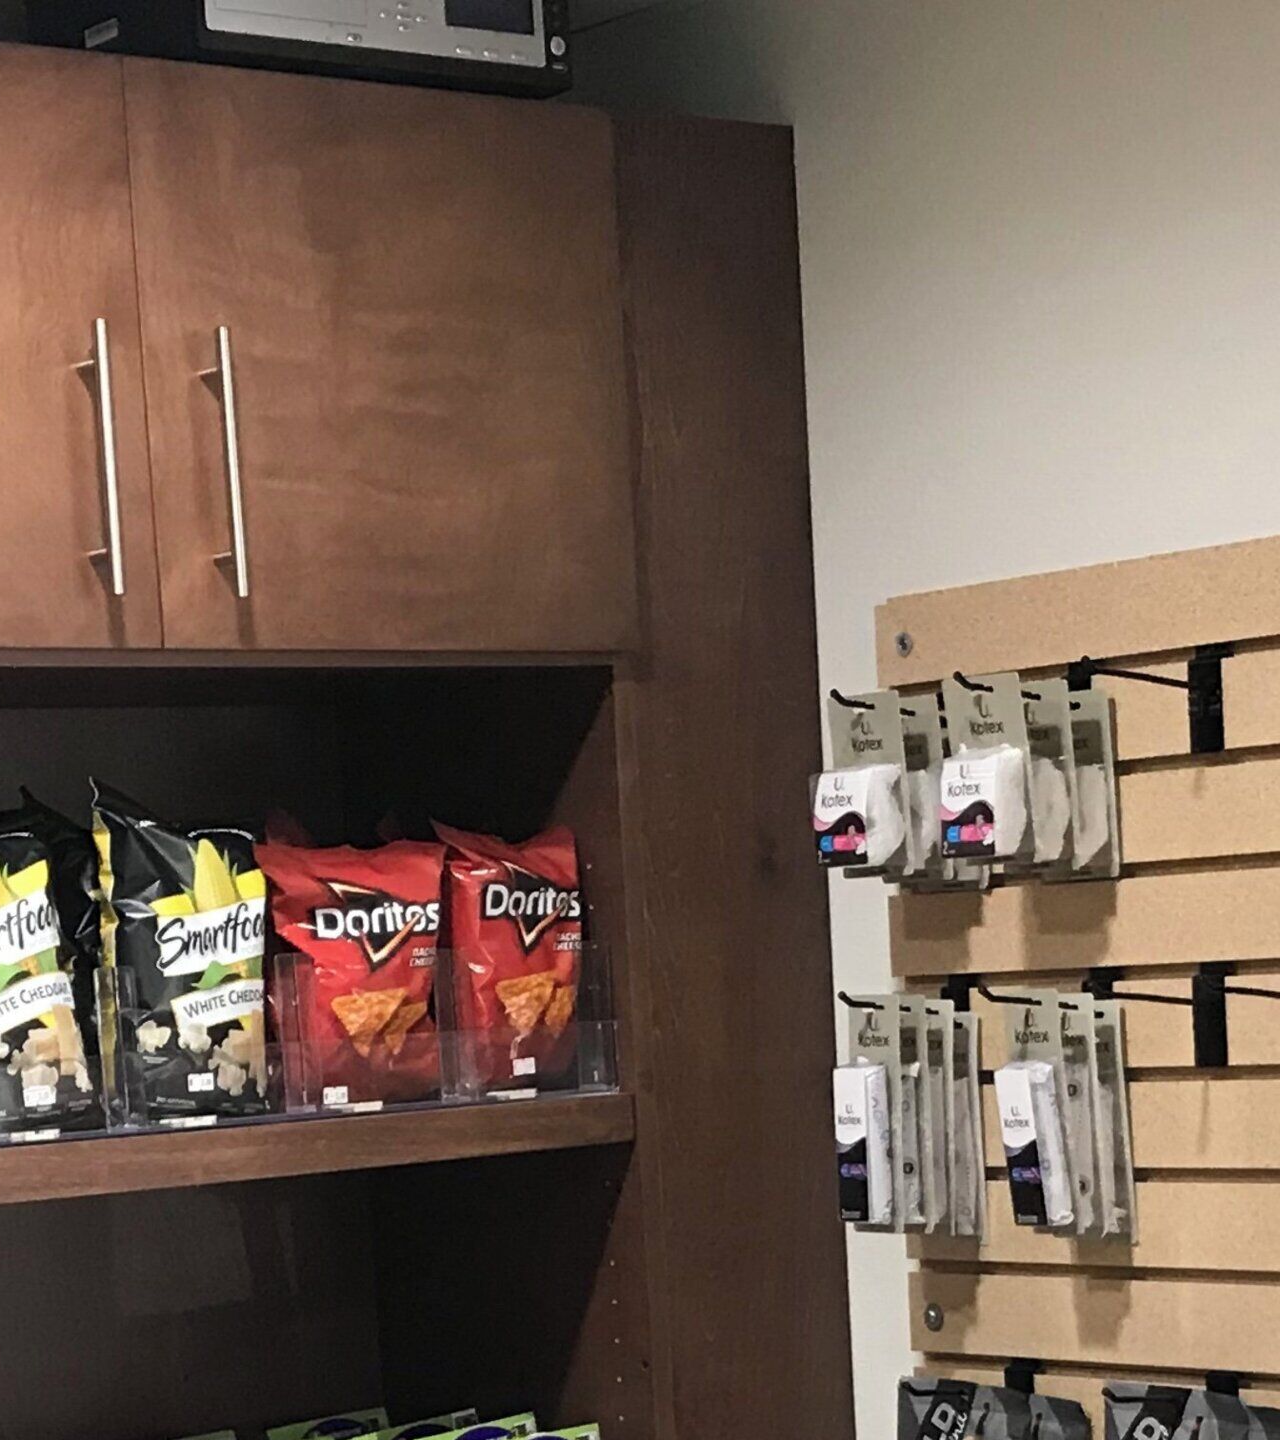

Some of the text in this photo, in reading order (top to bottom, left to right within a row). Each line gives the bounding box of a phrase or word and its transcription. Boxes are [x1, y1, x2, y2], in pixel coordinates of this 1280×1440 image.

[485, 884, 581, 918] Doritos
[156, 903, 265, 969] Smartfoo
[316, 903, 442, 940] Doritos
[183, 995, 227, 1018] WHITE
